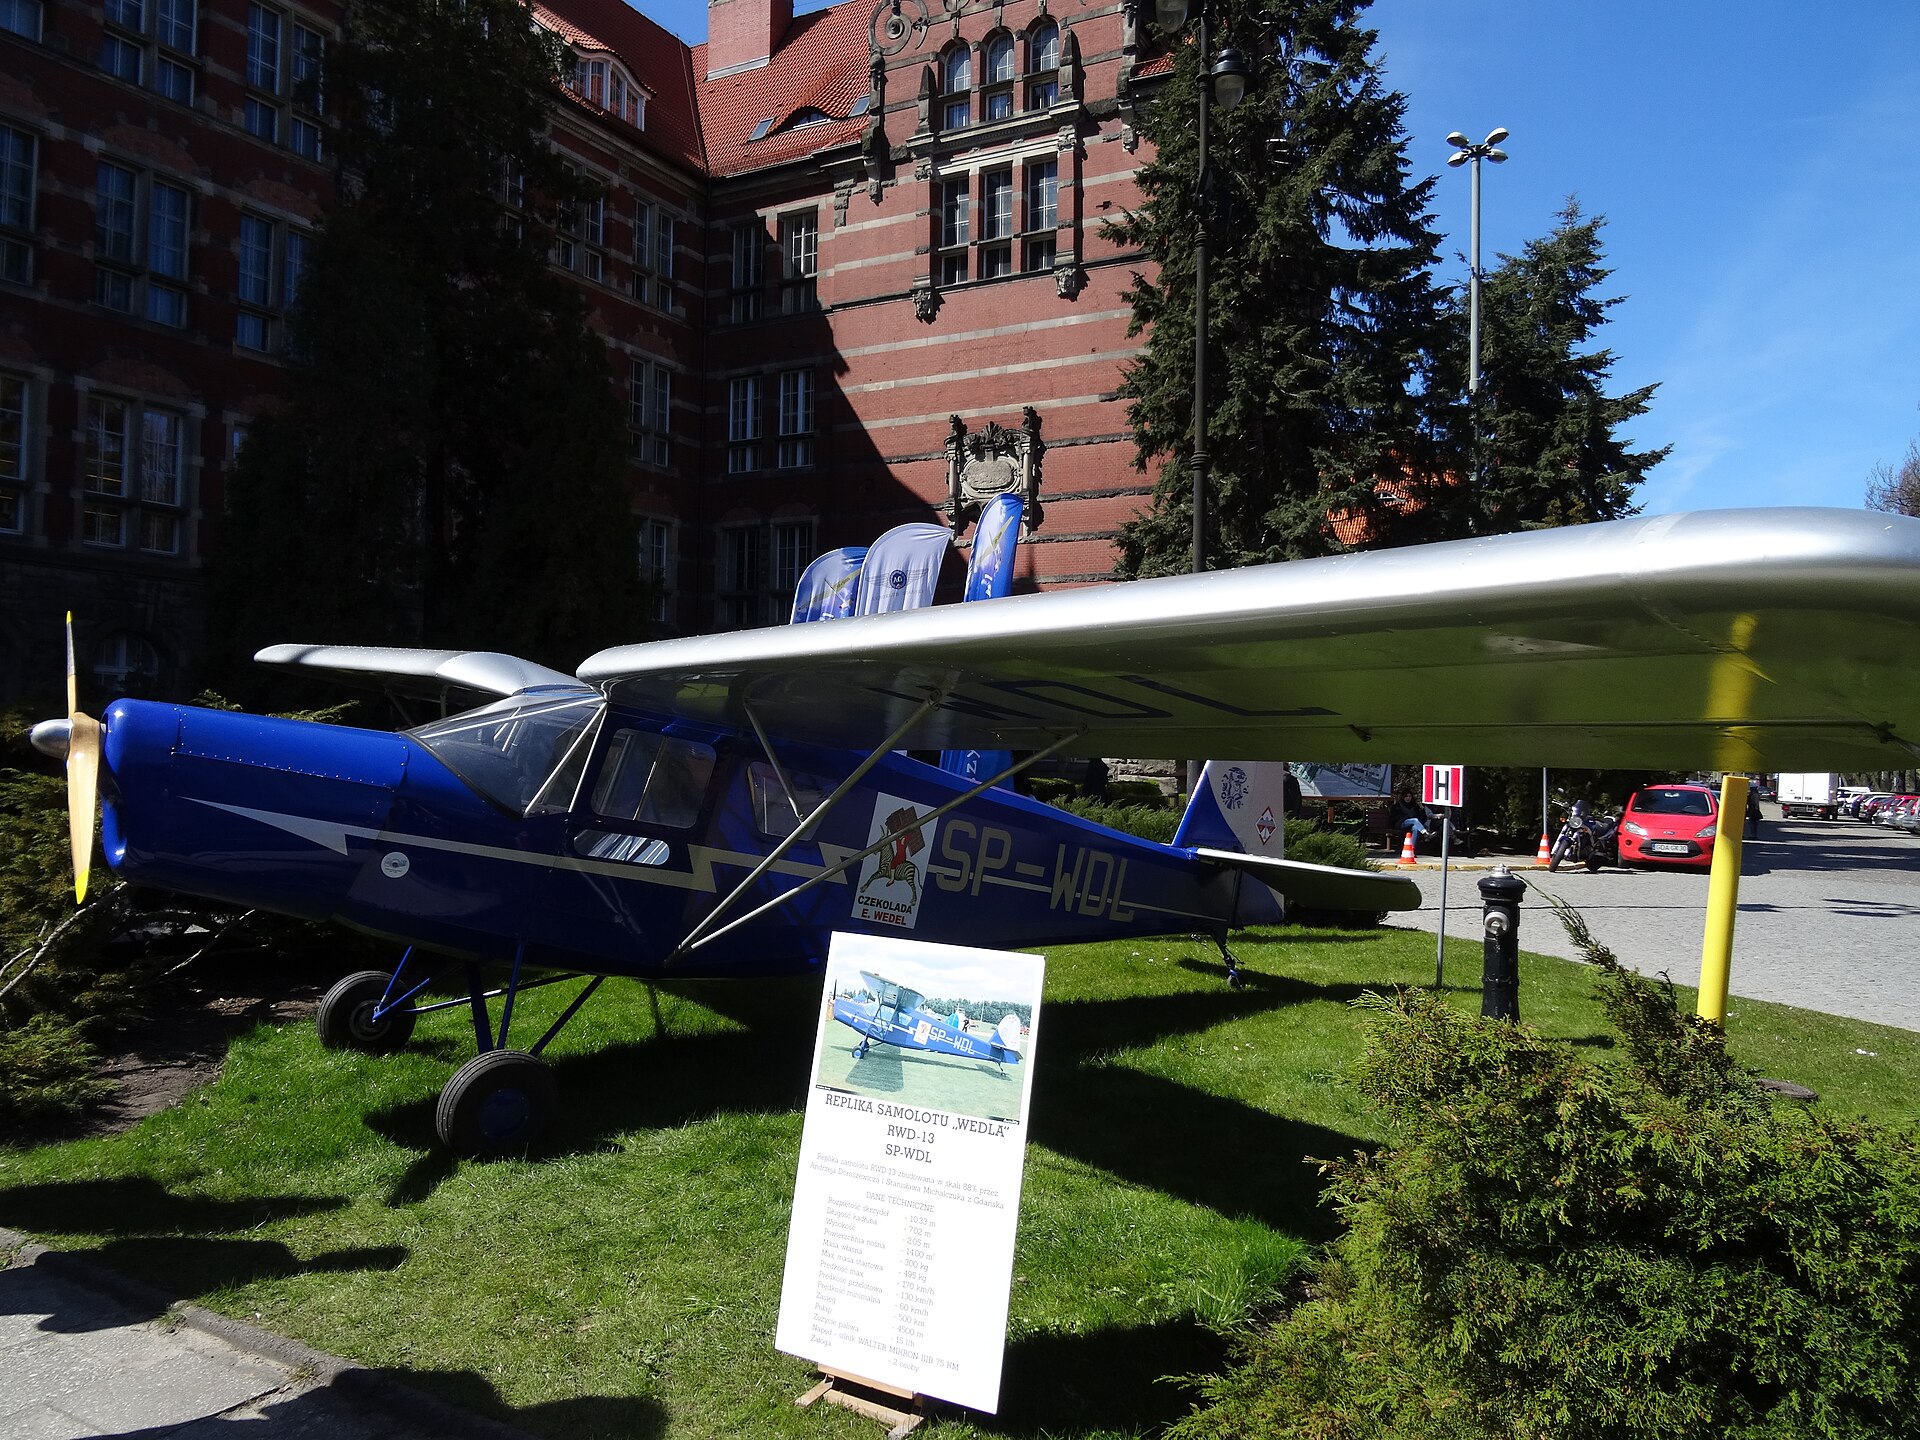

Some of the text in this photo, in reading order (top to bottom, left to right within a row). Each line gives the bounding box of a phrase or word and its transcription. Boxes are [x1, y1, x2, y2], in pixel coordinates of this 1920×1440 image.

[1435, 770, 1449, 800] H
[858, 896, 912, 914] CZEKOLADA
[862, 908, 906, 926] E. WEDEL
[826, 1094, 872, 1113] REPLIKA
[878, 1104, 949, 1126] SAMOLOTU
[886, 1124, 934, 1144] RWD-13
[886, 1144, 932, 1163] SP-WDL
[816, 1152, 838, 1163] Replika
[840, 1160, 868, 1170] samolotu
[870, 1164, 886, 1174] RWD
[888, 1168, 896, 1176] 13
[898, 1170, 934, 1184] zbudowana
[945, 1180, 960, 1190] skali
[962, 1182, 978, 1192] 88%
[979, 1188, 999, 1197] przez
[810, 1162, 836, 1174] Andrzeja
[923, 1186, 965, 1202] Michalczuka
[973, 1196, 1004, 1210] Gdańska
[866, 1190, 935, 1212] DANE TECHNICZNE
[822, 1238, 838, 1248] Masa
[920, 1261, 928, 1272] kg
[902, 1281, 914, 1290] 170
[918, 1273, 926, 1283] kg
[900, 1302, 909, 1311] 60
[858, 1336, 887, 1351] WALTER
[936, 1358, 944, 1367] 75
[892, 1358, 897, 1366] 2
